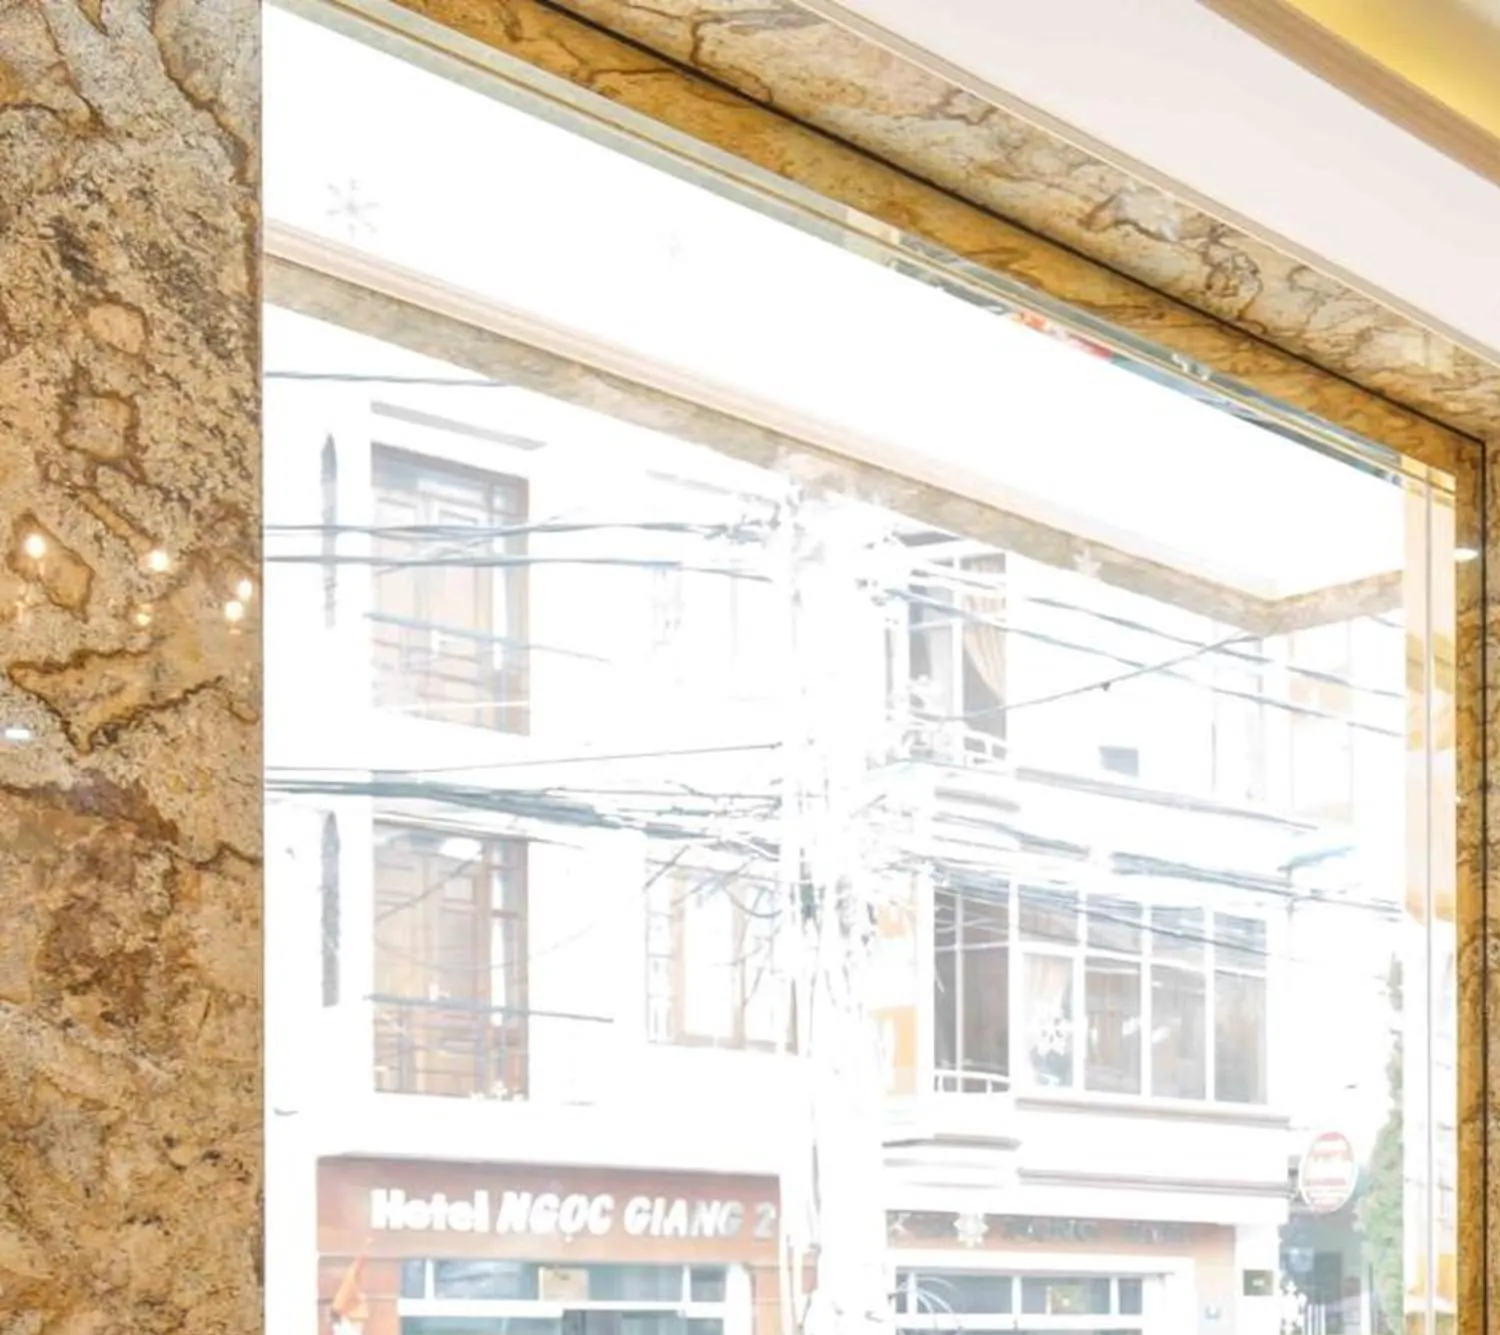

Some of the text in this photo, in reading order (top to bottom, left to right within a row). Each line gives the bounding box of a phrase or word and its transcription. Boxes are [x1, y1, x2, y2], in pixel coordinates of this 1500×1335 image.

[370, 1188, 776, 1243] Hotel NGỌC GIANG 2
